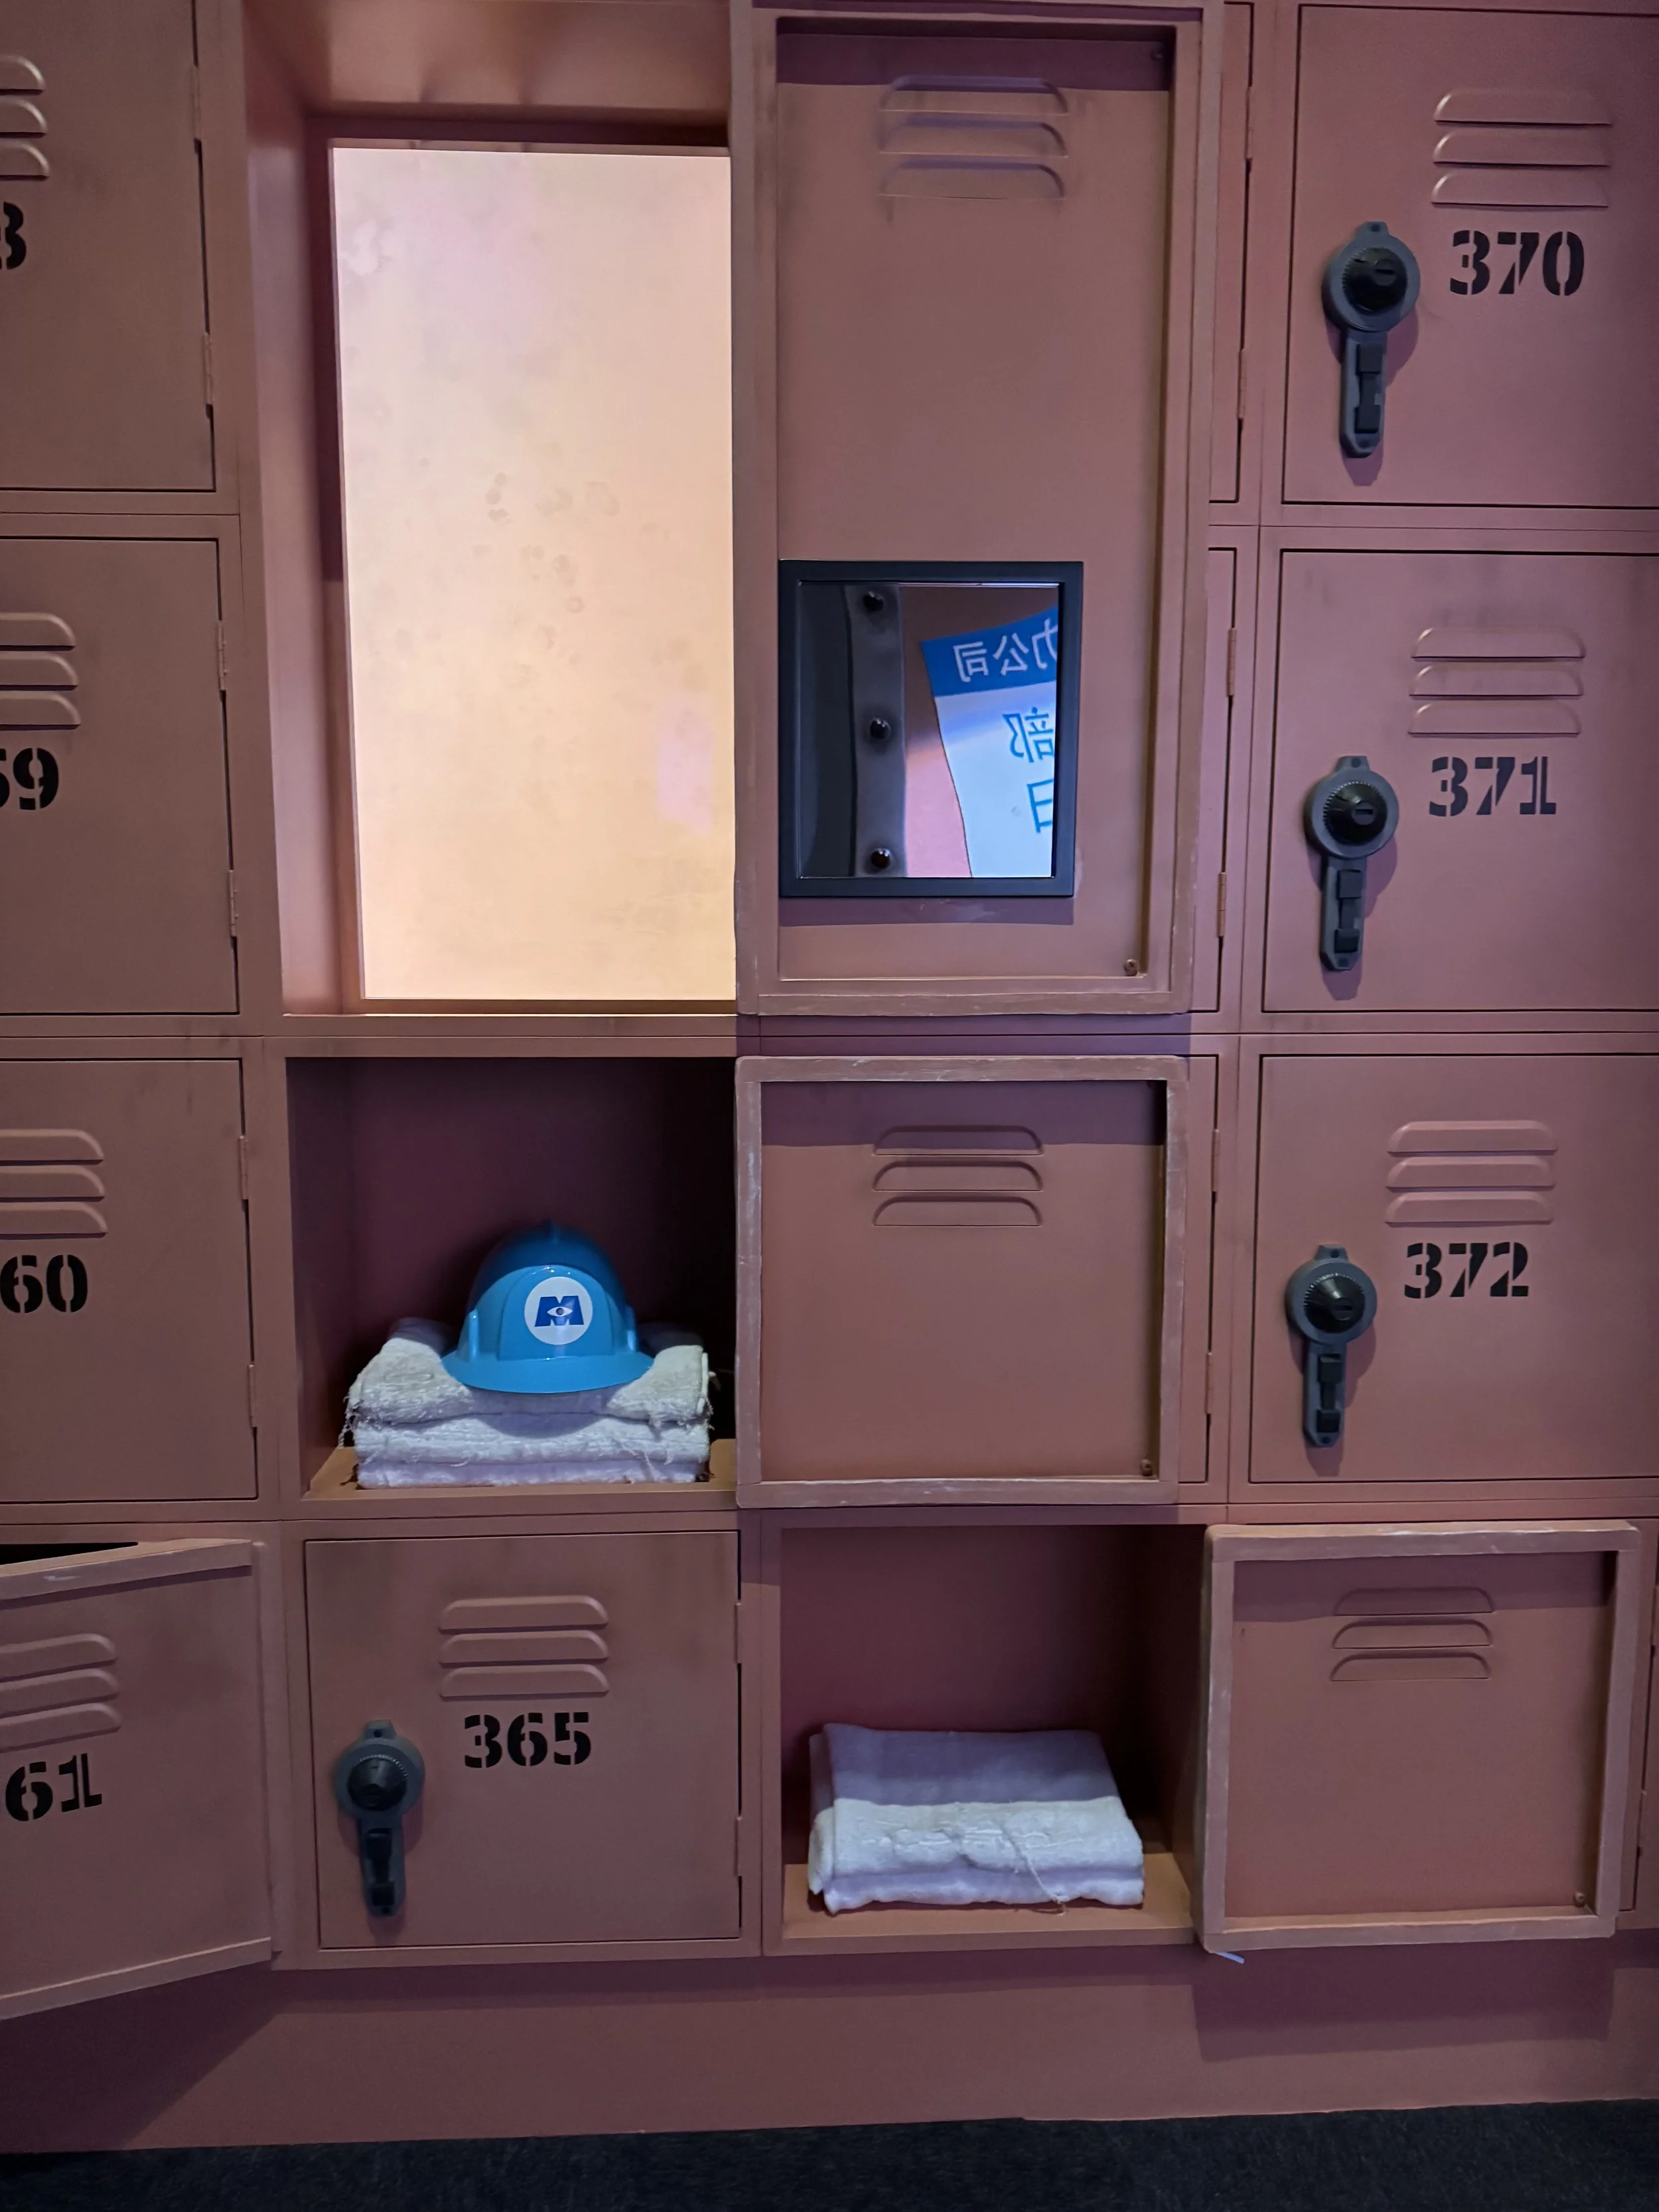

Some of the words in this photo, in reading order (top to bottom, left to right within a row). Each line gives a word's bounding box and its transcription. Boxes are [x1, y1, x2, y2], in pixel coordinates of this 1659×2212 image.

[1449, 230, 1585, 297] 370
[0, 748, 59, 810] 9
[1429, 757, 1556, 817] 371
[0, 1255, 88, 1313] 60
[1404, 1242, 1529, 1299] 372
[464, 1712, 591, 1769] 365
[5, 1752, 102, 1821] 61
